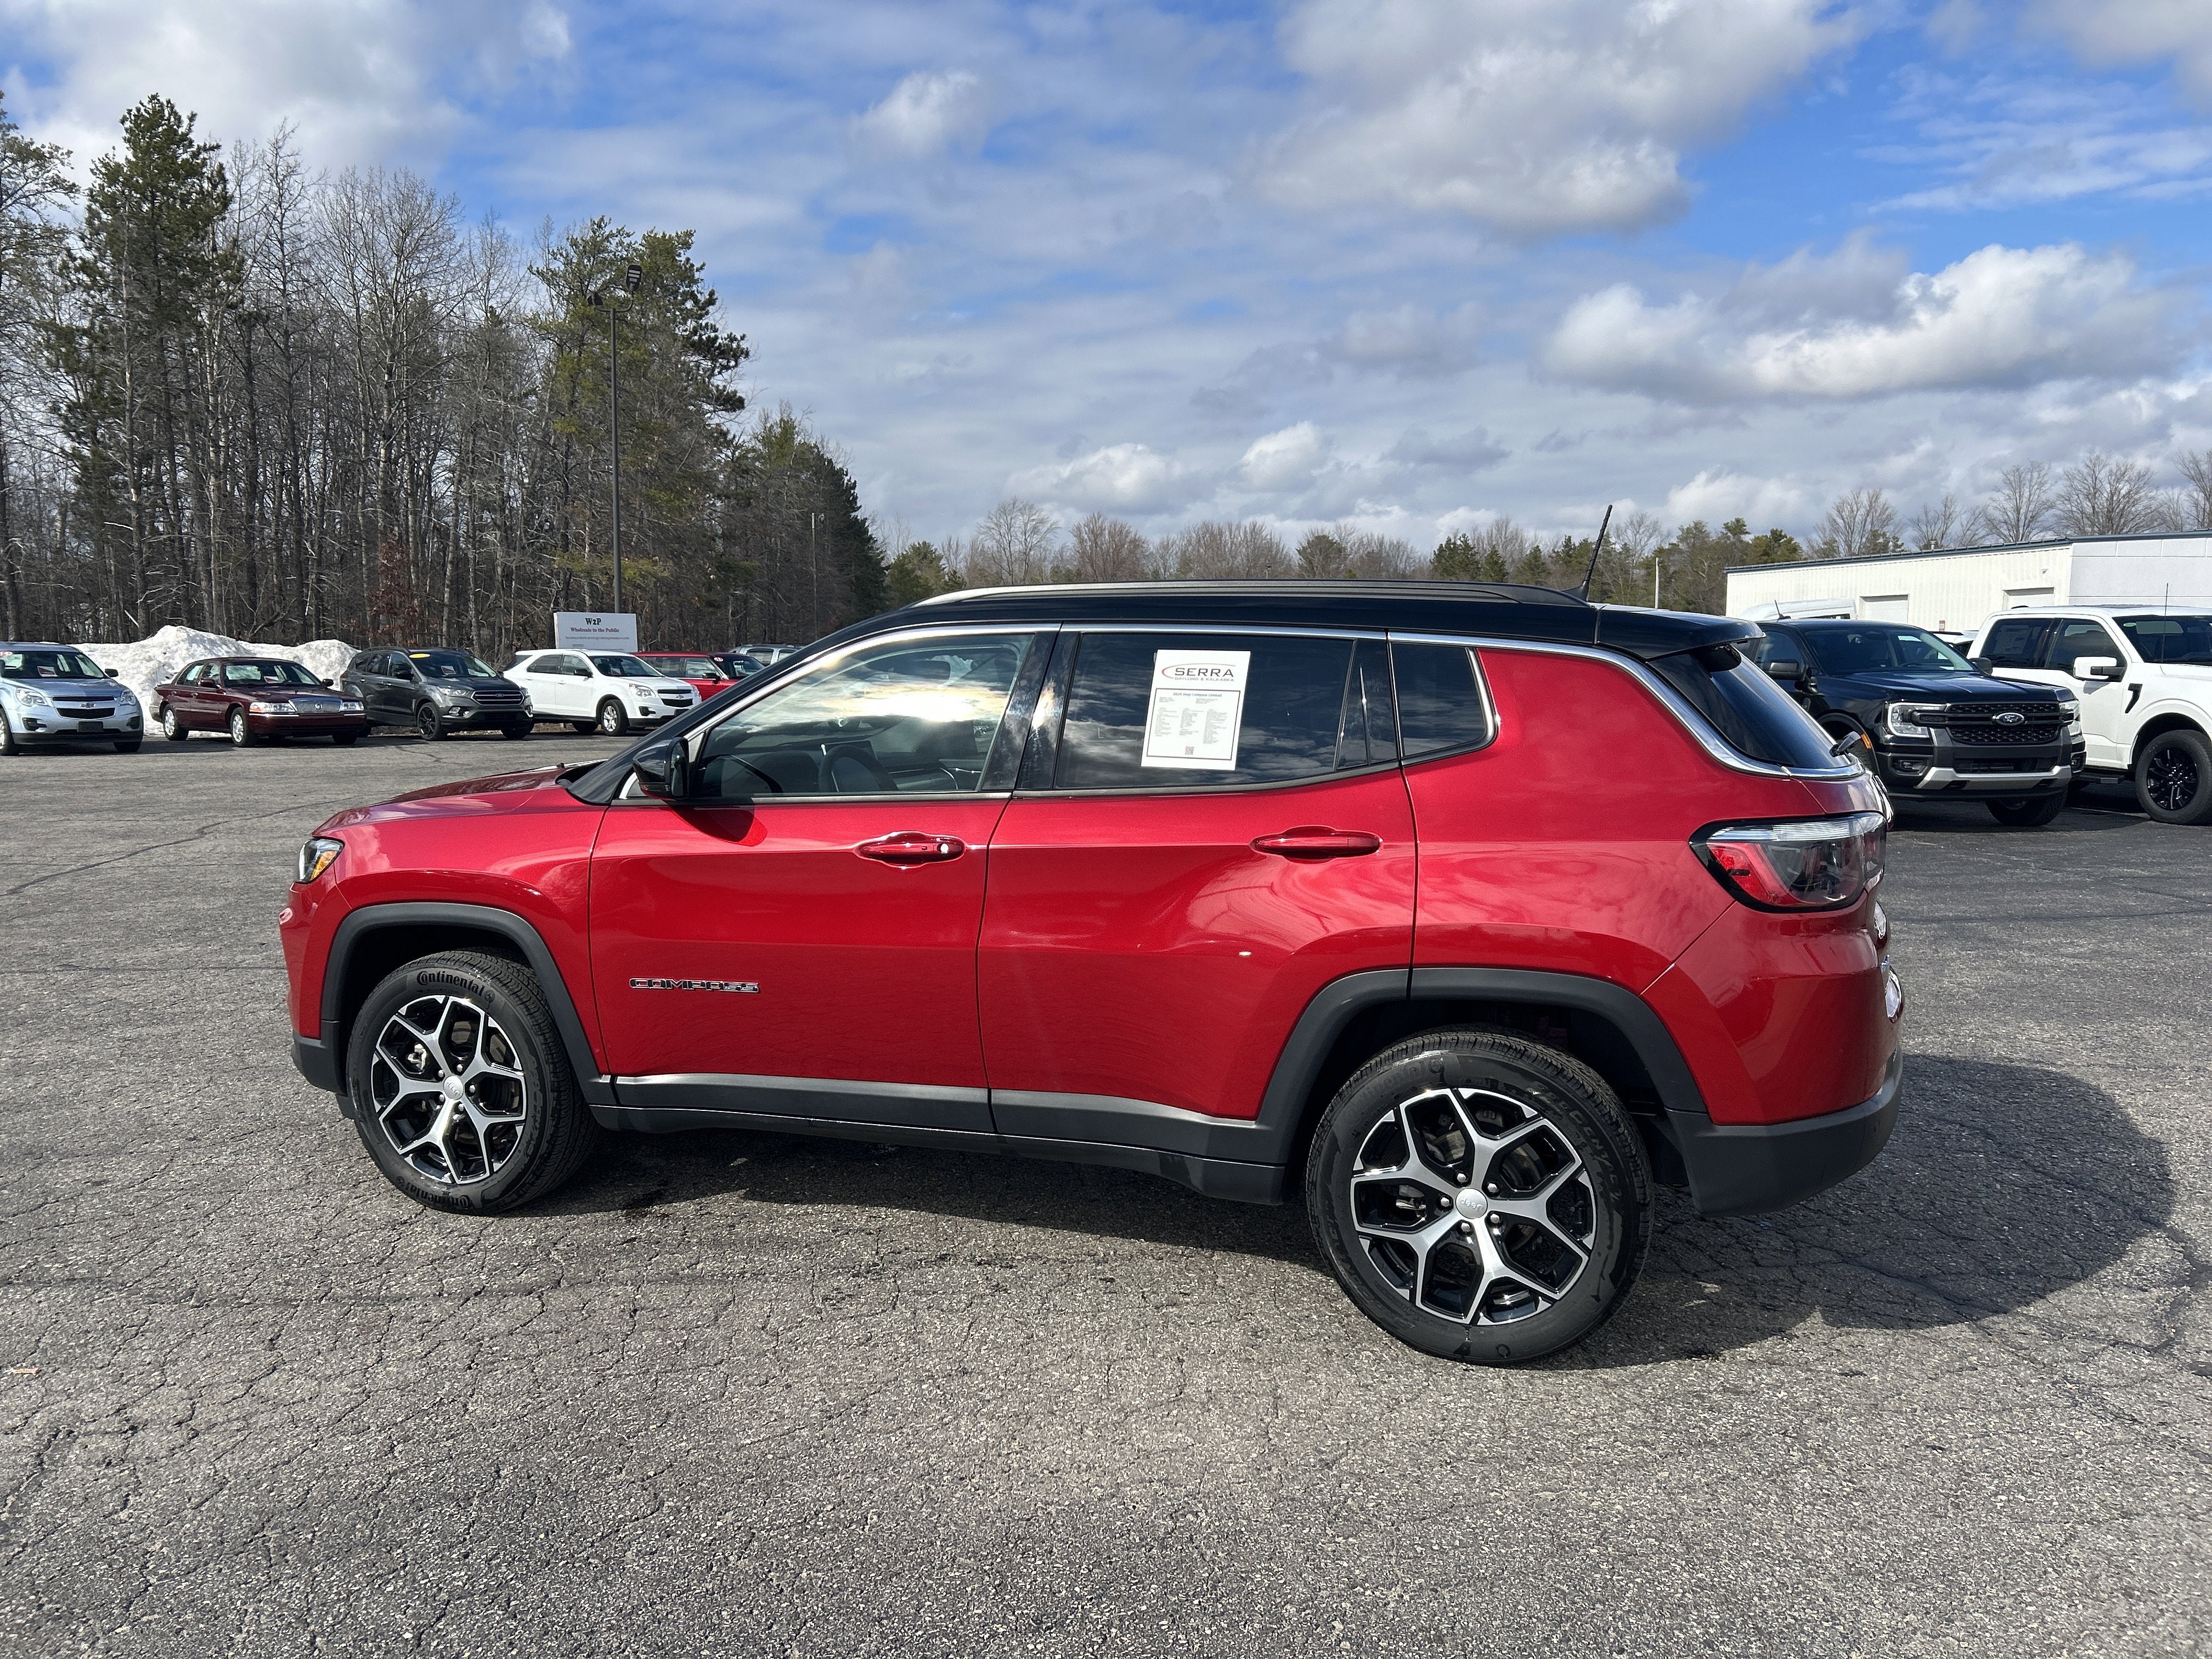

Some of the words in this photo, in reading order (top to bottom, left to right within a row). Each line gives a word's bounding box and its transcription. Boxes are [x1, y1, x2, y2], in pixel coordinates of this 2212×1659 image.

[1175, 668, 1234, 677] SERRA
[416, 970, 485, 996] Continental
[629, 978, 759, 993] COMPASS
